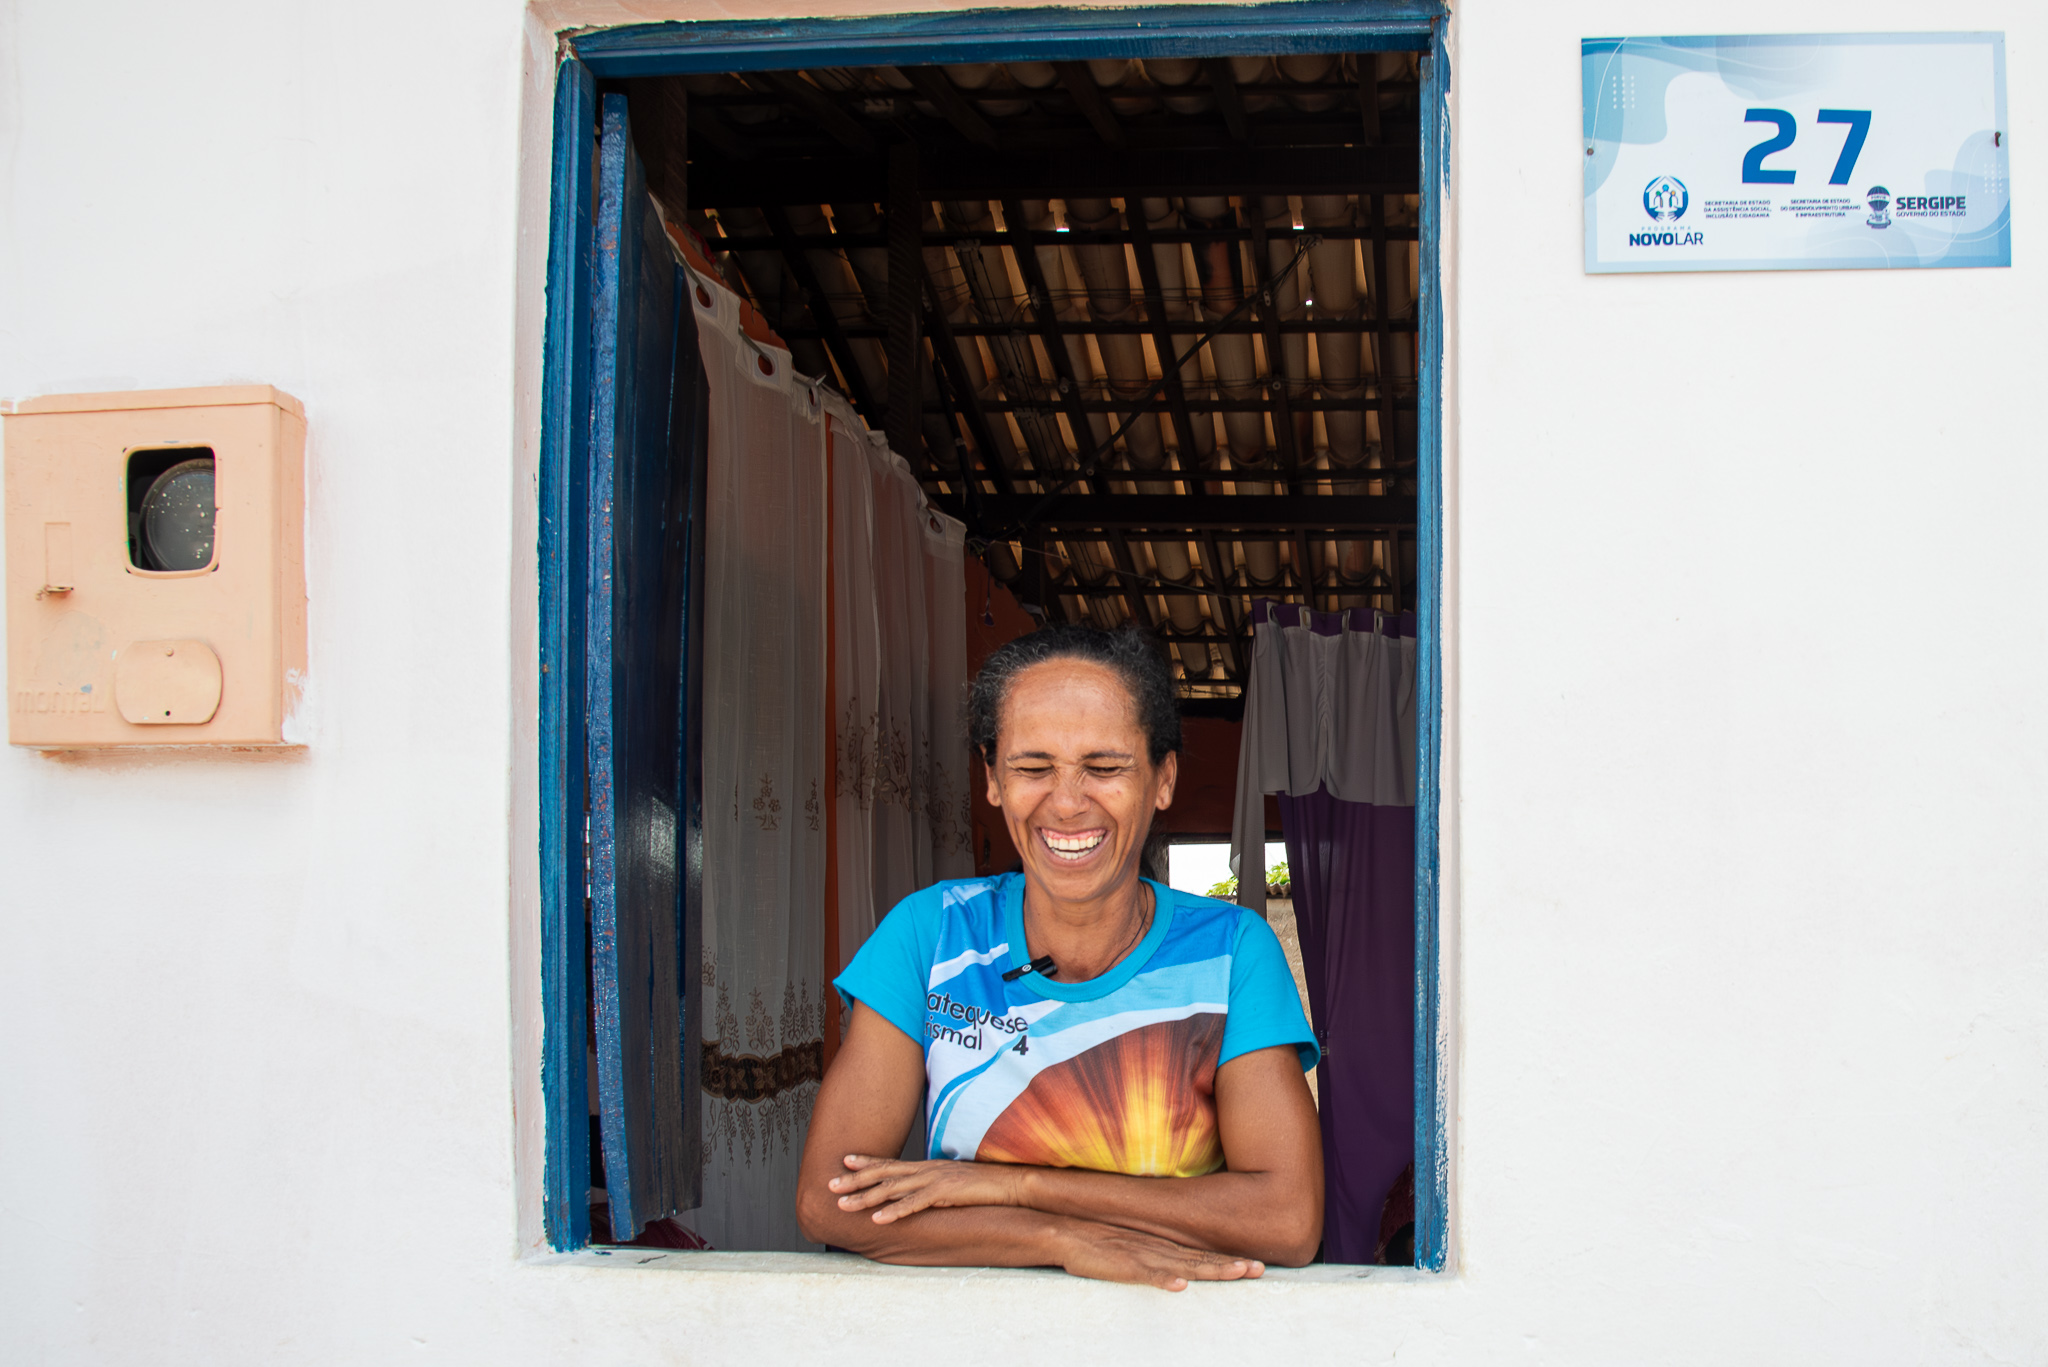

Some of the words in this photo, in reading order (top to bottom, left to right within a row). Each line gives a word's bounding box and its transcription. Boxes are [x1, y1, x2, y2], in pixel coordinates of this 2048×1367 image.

[1742, 108, 1872, 185] 27
[1896, 196, 1966, 210] SERGIPE
[926, 992, 1029, 1034] atequese
[924, 1015, 983, 1051] rismal
[1011, 1034, 1030, 1056] 4
